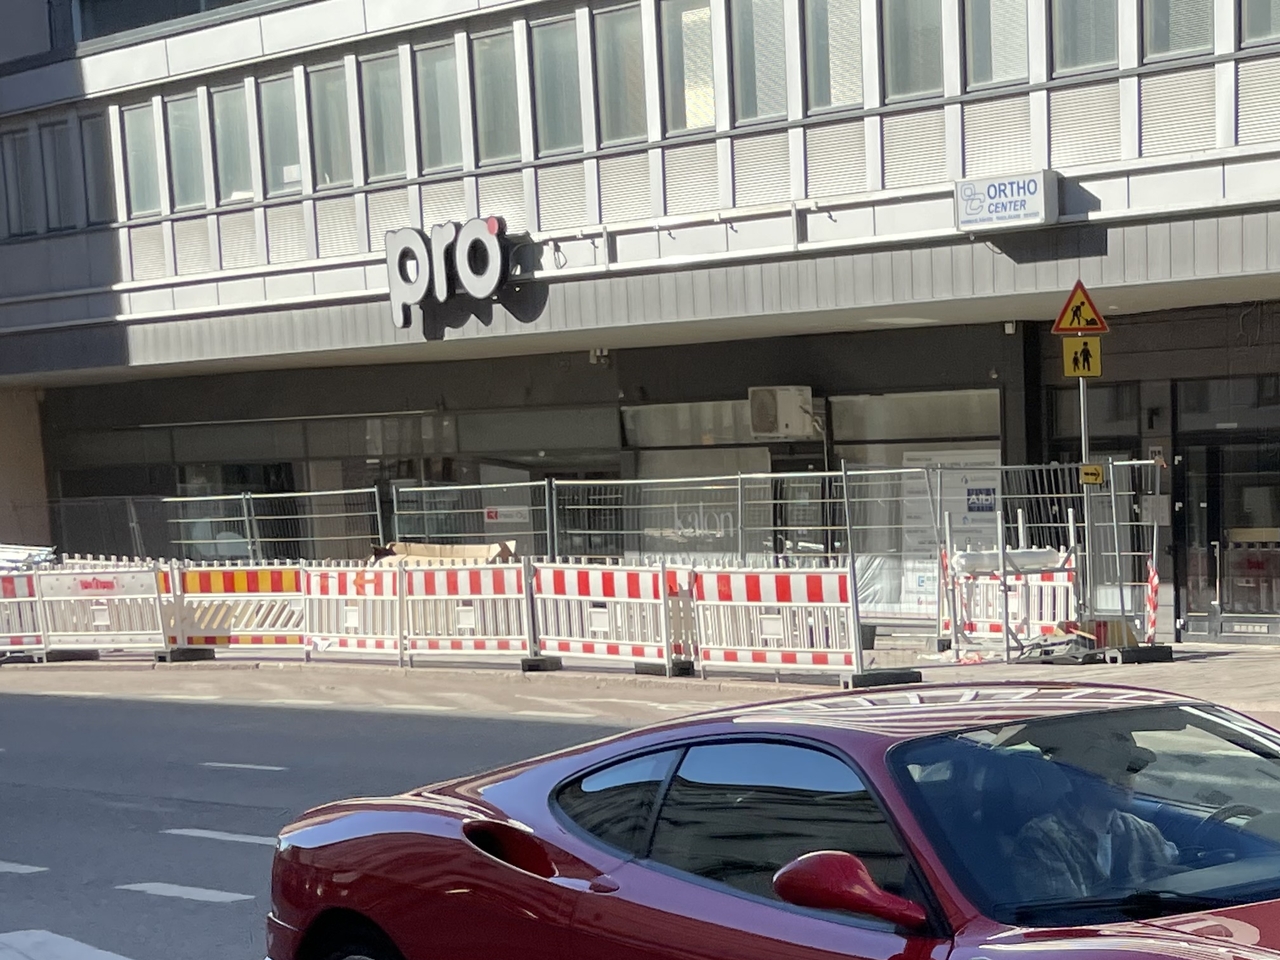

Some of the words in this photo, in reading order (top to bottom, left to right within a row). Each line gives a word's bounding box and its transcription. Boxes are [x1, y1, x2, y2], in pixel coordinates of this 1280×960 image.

[987, 178, 1038, 200] ORTHO
[987, 199, 1027, 214] CENTER
[385, 216, 502, 328] pro
[673, 501, 734, 538] kalon
